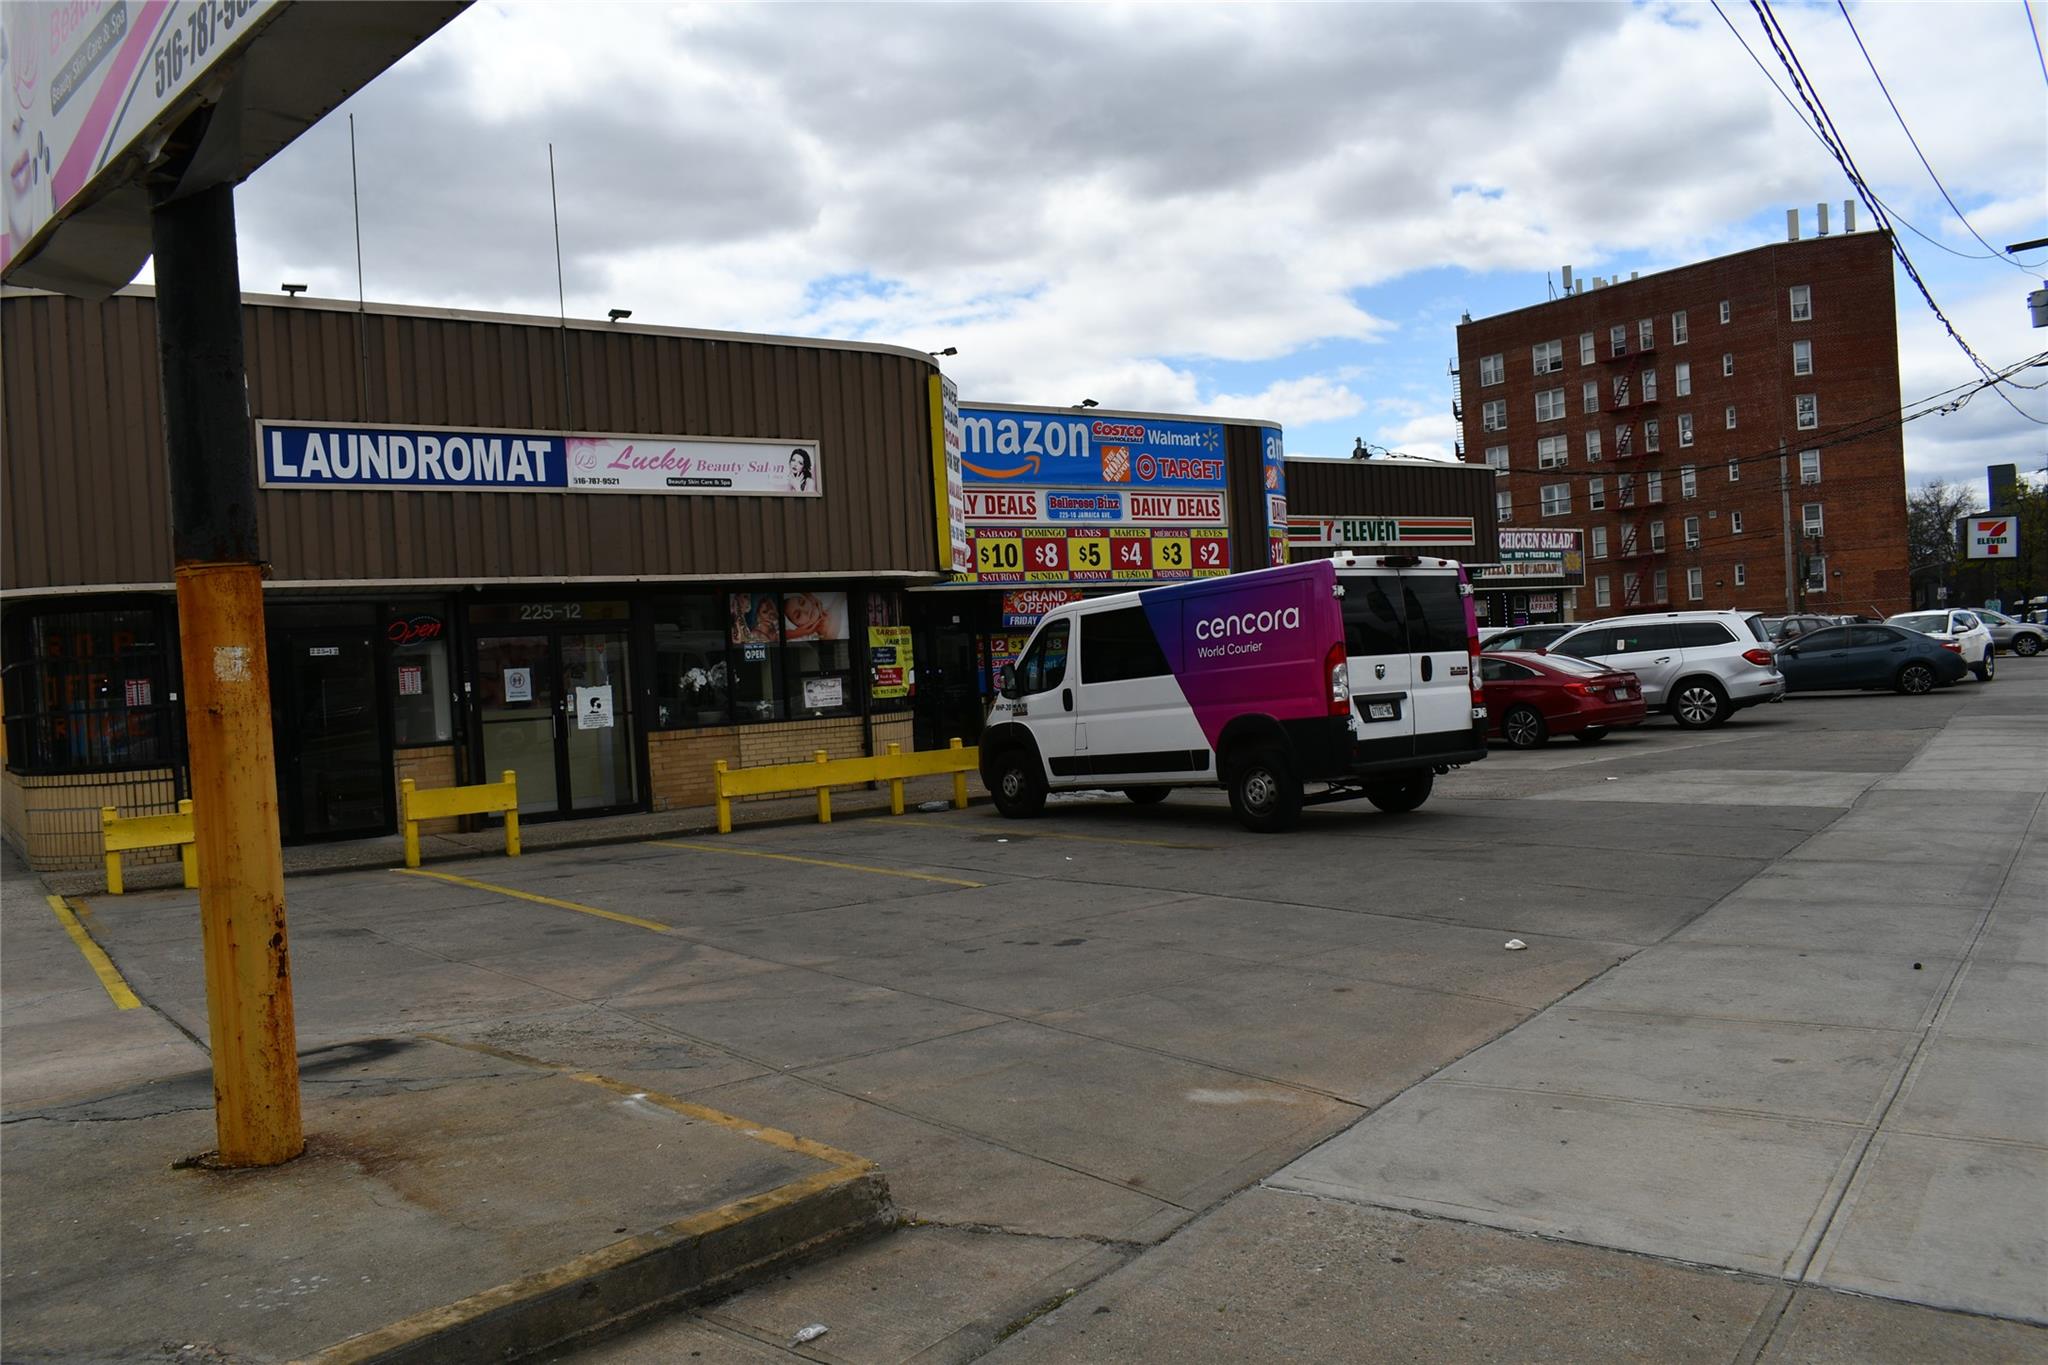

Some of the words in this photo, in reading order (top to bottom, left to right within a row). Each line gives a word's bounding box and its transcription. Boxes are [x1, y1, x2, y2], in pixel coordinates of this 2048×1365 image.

[958, 416, 1090, 458] mazon
[1148, 429, 1200, 447] Walmart
[271, 431, 551, 482] LAUNDROMAT
[607, 445, 693, 476] Lucky
[697, 460, 744, 475] Beauty
[1103, 447, 1130, 482] HOME
[1158, 458, 1224, 480] TARGET
[573, 477, 620, 485] 516-787-9521
[984, 493, 1037, 516] DEALS
[1050, 496, 1095, 509] Bellerose
[1097, 496, 1120, 509] Binz
[1131, 495, 1172, 517] DAILY
[1177, 497, 1220, 518] DEALS
[1078, 511, 1100, 519] JAMAICA
[1024, 528, 1065, 537] DOMINGO
[1074, 529, 1101, 537] LUNES
[1499, 532, 1540, 549] CHICKEN
[1541, 533, 1574, 549] SALAD!
[981, 543, 1018, 568] $10
[1035, 543, 1059, 567] $8
[1079, 543, 1101, 566] $5
[1121, 542, 1143, 566] $4
[1162, 542, 1182, 565] $3
[1200, 542, 1220, 565] $2
[1271, 542, 1283, 564] $12
[982, 573, 1022, 581] SATURDAY
[1031, 572, 1065, 580] SUNDAY
[1073, 571, 1108, 579] MONDAY
[1117, 571, 1150, 579] TUESDAY
[1156, 570, 1190, 578] WEDNESDAY
[1196, 569, 1228, 577] THURSDAY
[1023, 590, 1068, 602] GRAND
[520, 604, 581, 620] 225-12
[1017, 602, 1067, 614] OPENI
[1009, 616, 1038, 625] FRIDAY
[1196, 607, 1300, 641] cencora
[388, 621, 442, 644] Open
[745, 649, 765, 660] OPEN
[1198, 645, 1225, 659] World
[1227, 641, 1263, 656] Courier
